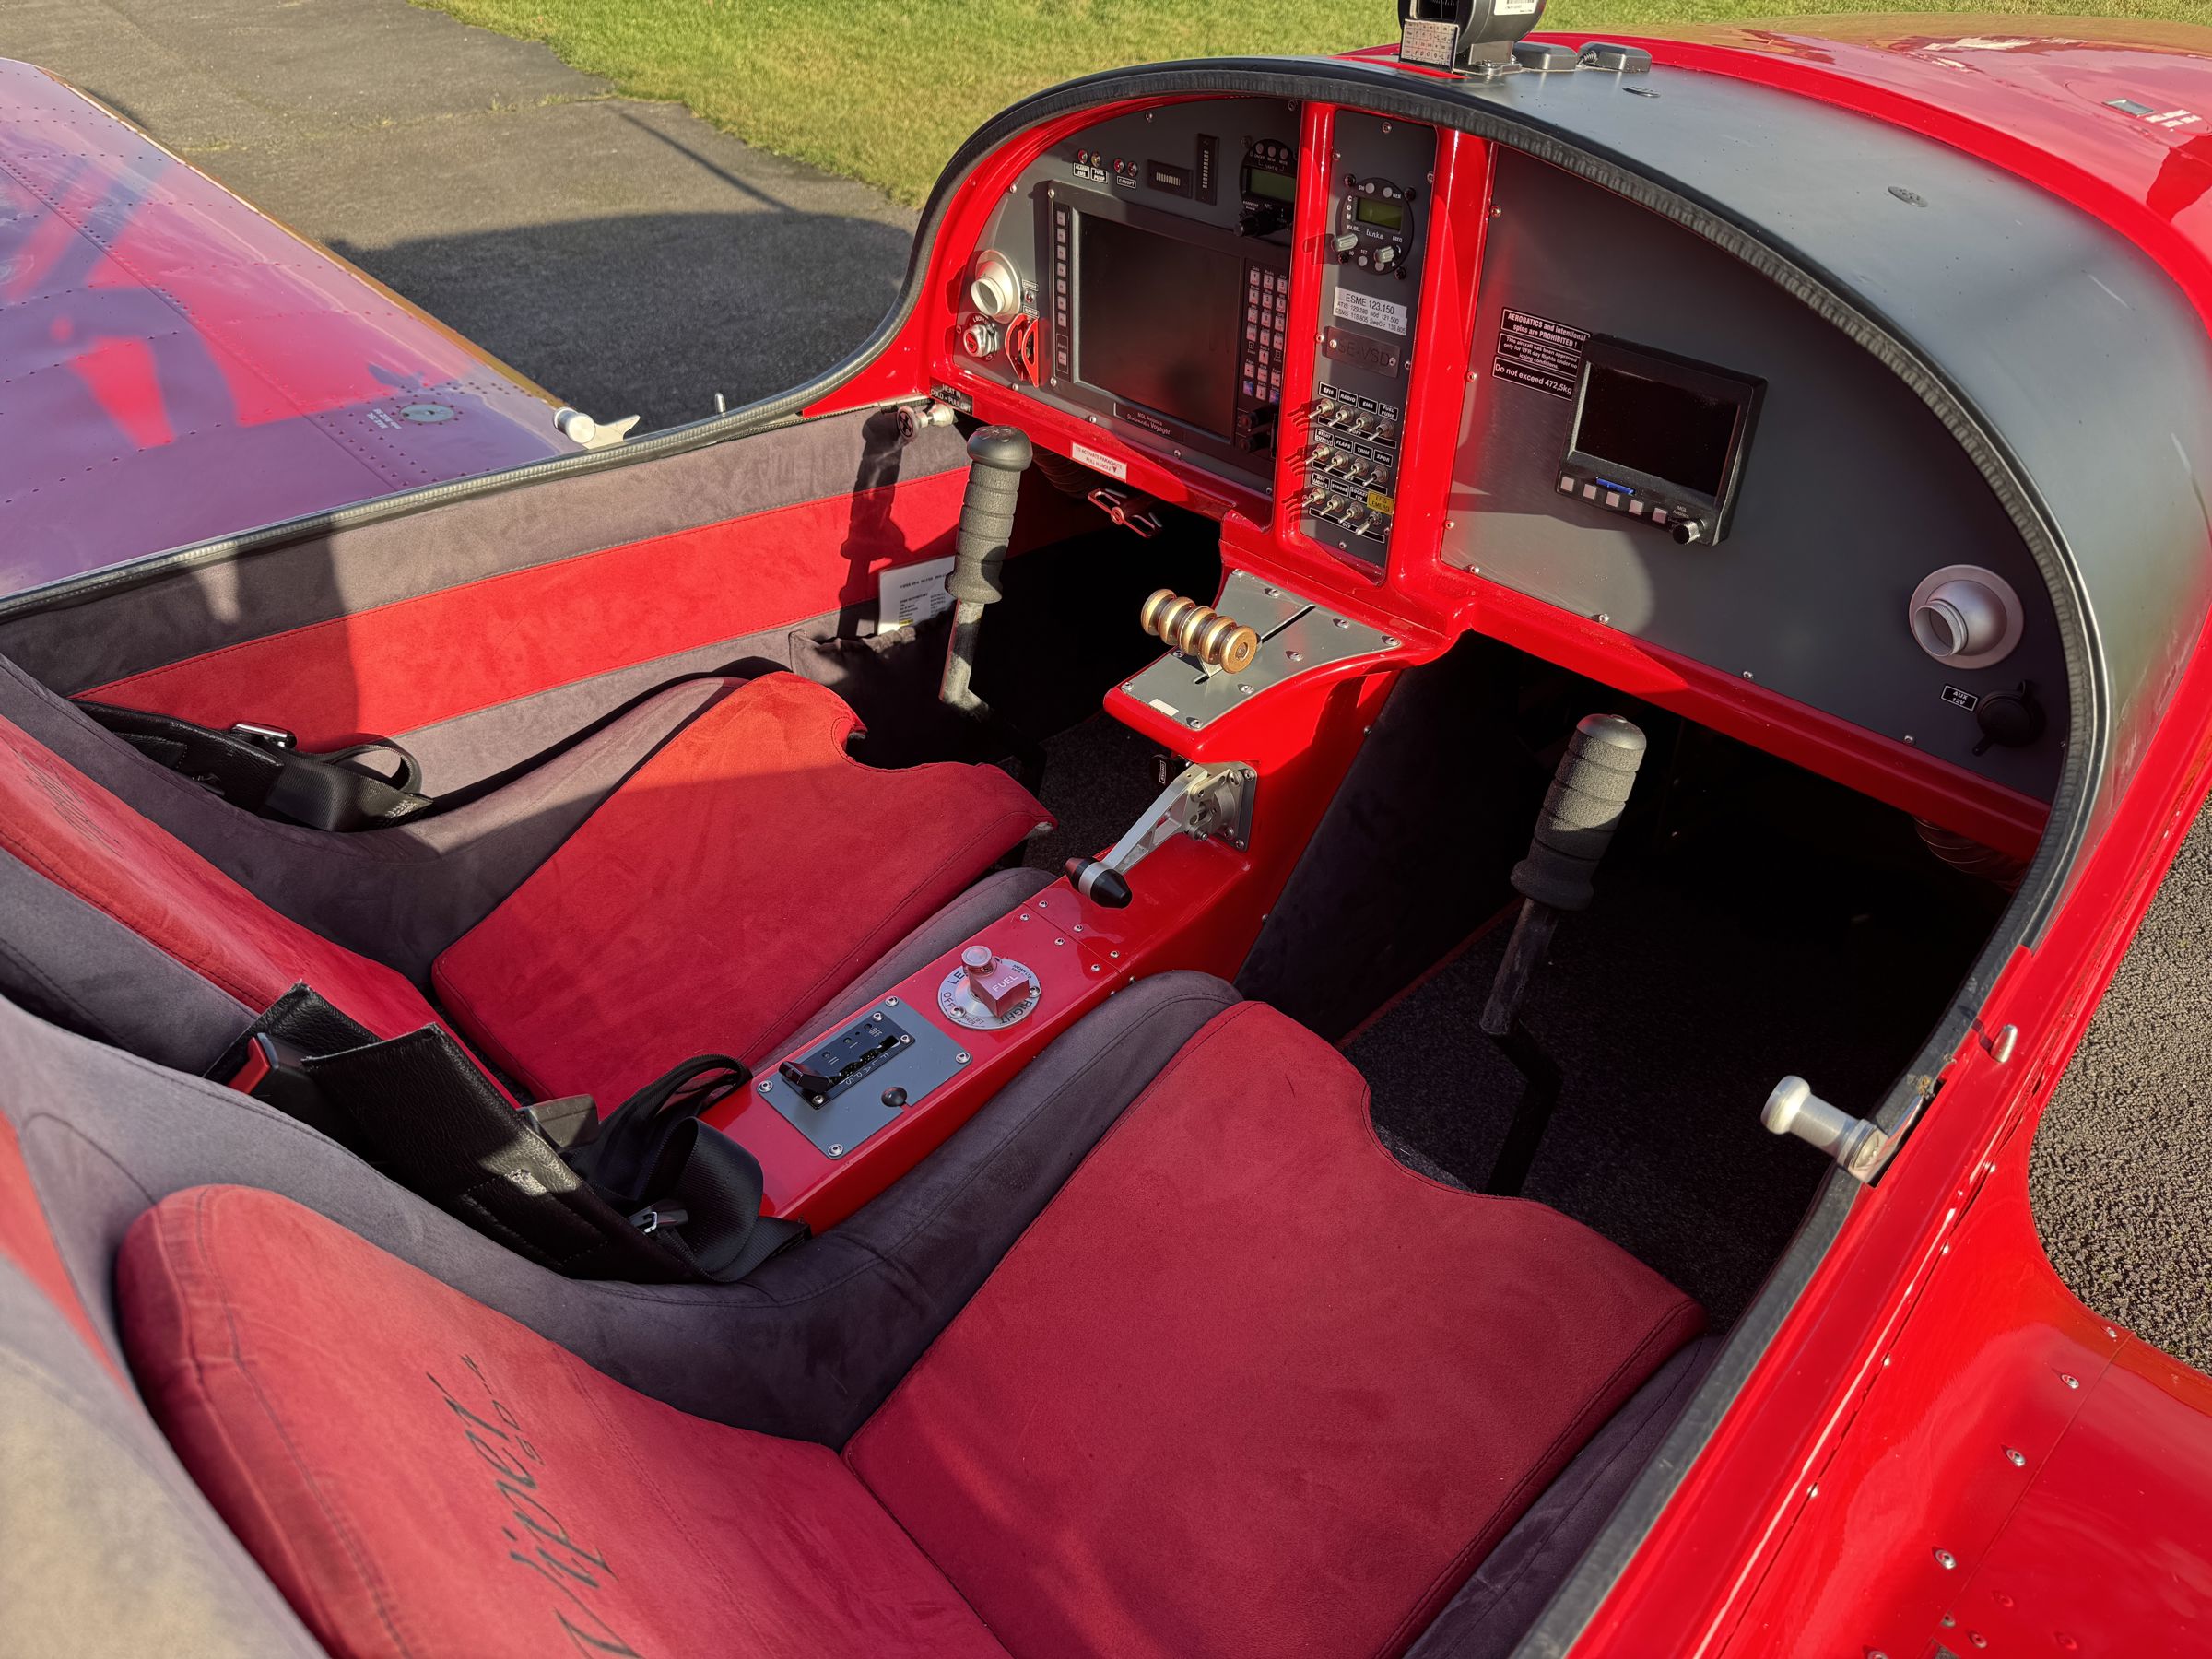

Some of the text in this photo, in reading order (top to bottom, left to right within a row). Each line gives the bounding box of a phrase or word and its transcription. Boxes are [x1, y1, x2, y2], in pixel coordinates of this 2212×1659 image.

[1118, 178, 1135, 187] CANOPY
[1335, 308, 1348, 317] ESMS
[1337, 301, 1348, 310] ATIS
[1382, 313, 1400, 324] 121.500
[1346, 293, 1394, 315] ESME 123.150
[1507, 312, 1586, 341] AEROBATICS and intentional
[1512, 324, 1528, 335] spins
[1538, 331, 1573, 347] PROHIBITED
[1337, 338, 1390, 367] SE-VSD
[1503, 343, 1513, 351] only
[1532, 349, 1540, 359] day
[1541, 351, 1556, 362] flights
[1556, 357, 1571, 366] under
[1516, 339, 1534, 348] aircraft
[1543, 347, 1555, 356] been
[1555, 351, 1578, 363] approved
[942, 383, 955, 394] HEAT
[1495, 363, 1572, 395] Do not exceed 472,5kg
[1339, 393, 1356, 404] RADIO
[1335, 440, 1351, 450] FLAPS
[1357, 447, 1371, 455] TRIM
[1952, 697, 1966, 705] 12V
[1953, 691, 1968, 700] AUX
[992, 975, 1018, 992] FUEL
[943, 991, 957, 1008] OFF
[1000, 999, 1033, 1024] RIGHT
[868, 1027, 883, 1038] OFF
[845, 1053, 889, 1085] FLAPS
[426, 1371, 645, 1659] Viper
